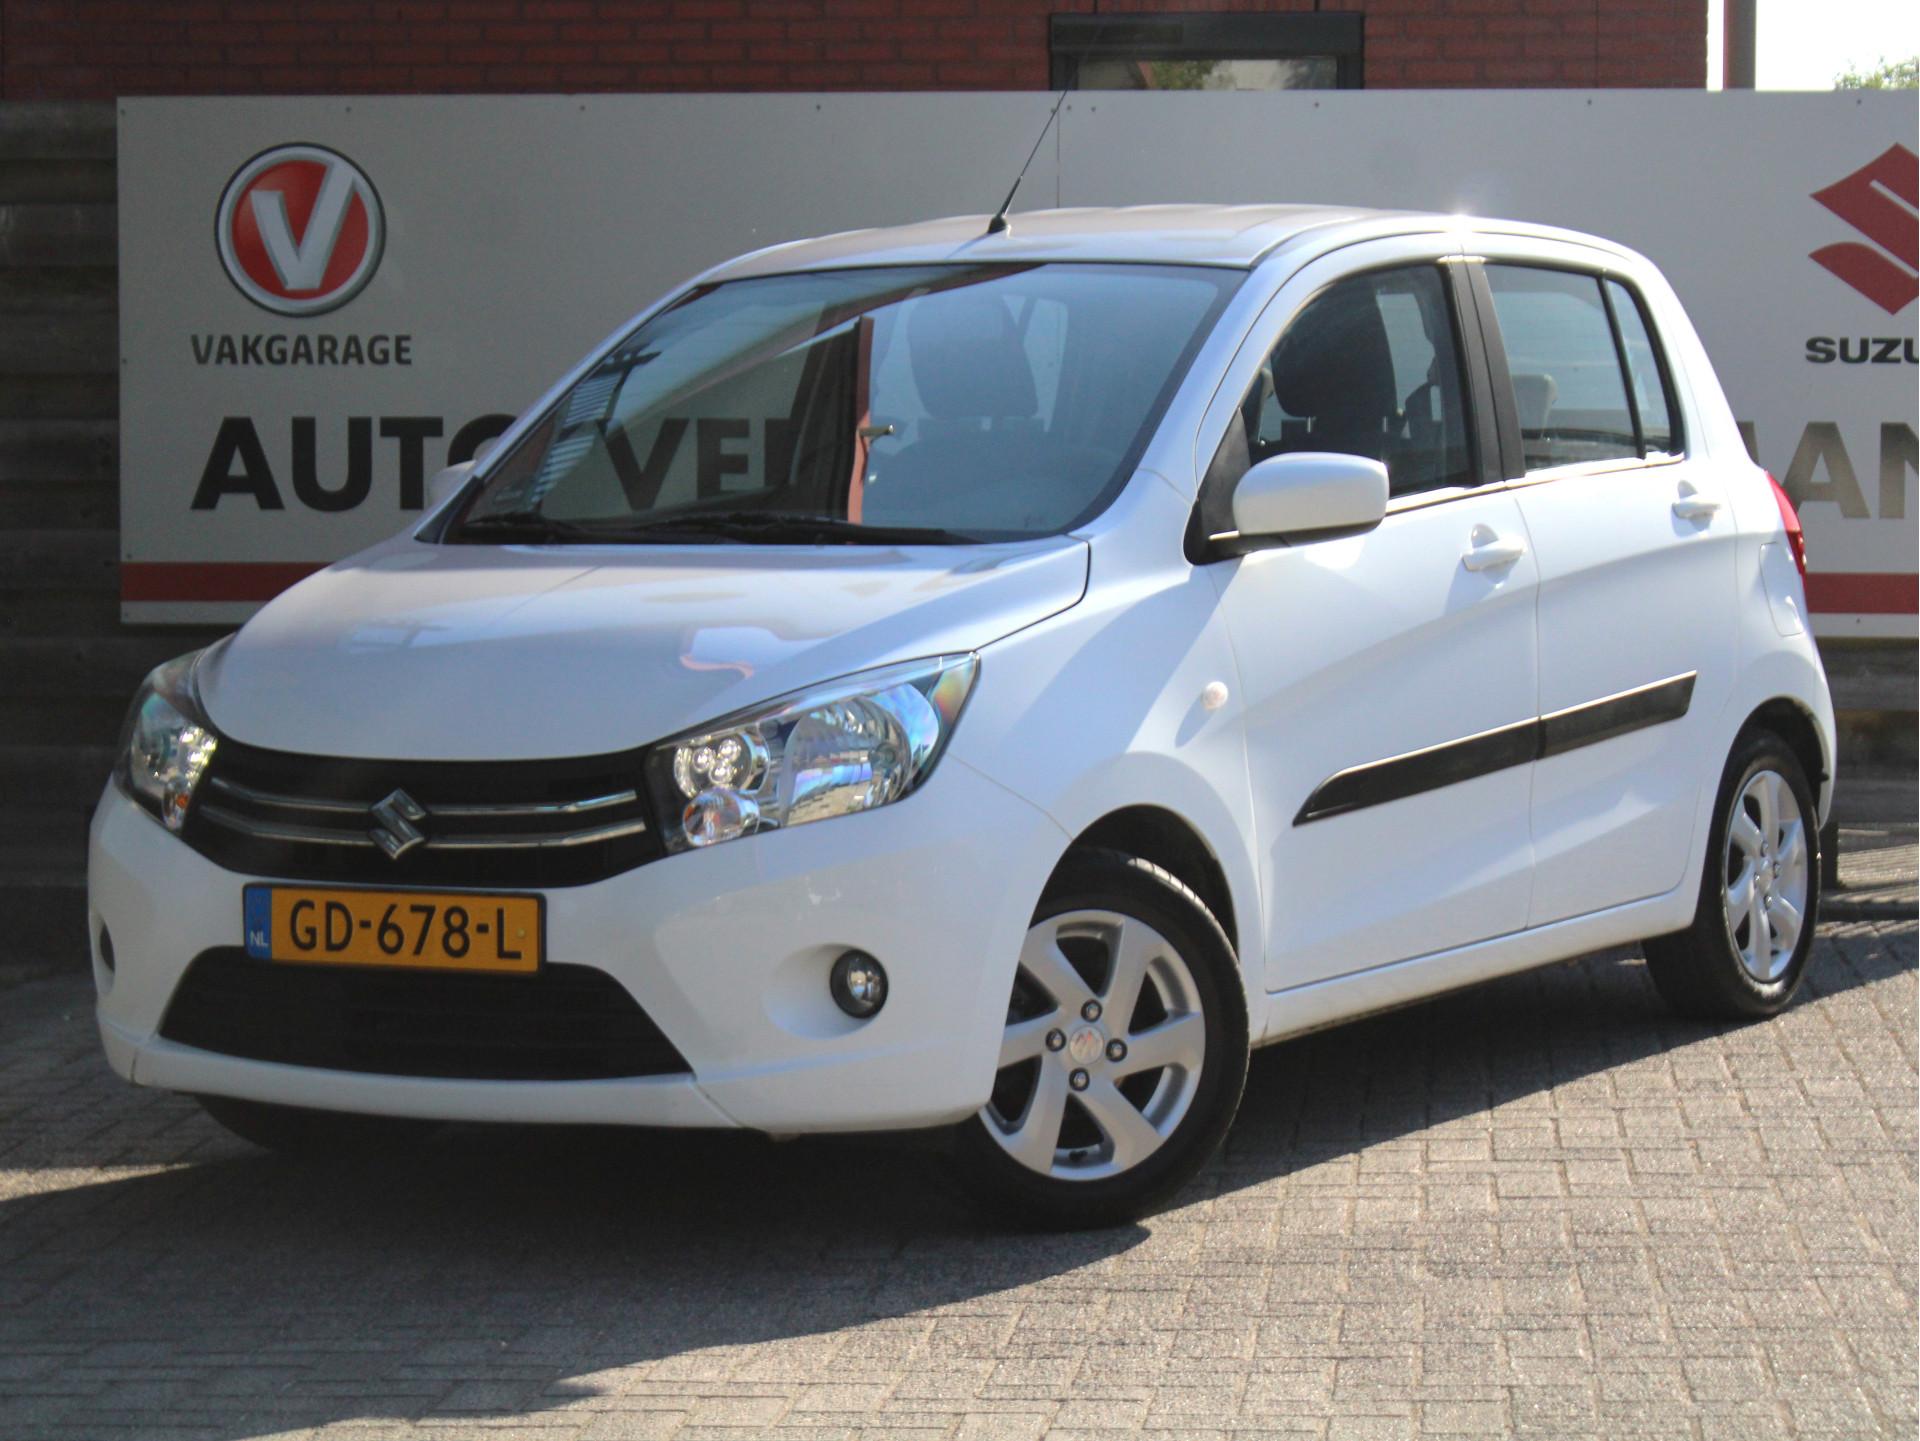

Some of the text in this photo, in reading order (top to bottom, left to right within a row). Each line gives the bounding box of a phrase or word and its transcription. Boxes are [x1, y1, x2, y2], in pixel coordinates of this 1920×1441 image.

[190, 334, 413, 365] VAKGARAGE
[249, 899, 523, 961] NL GD-678-L
